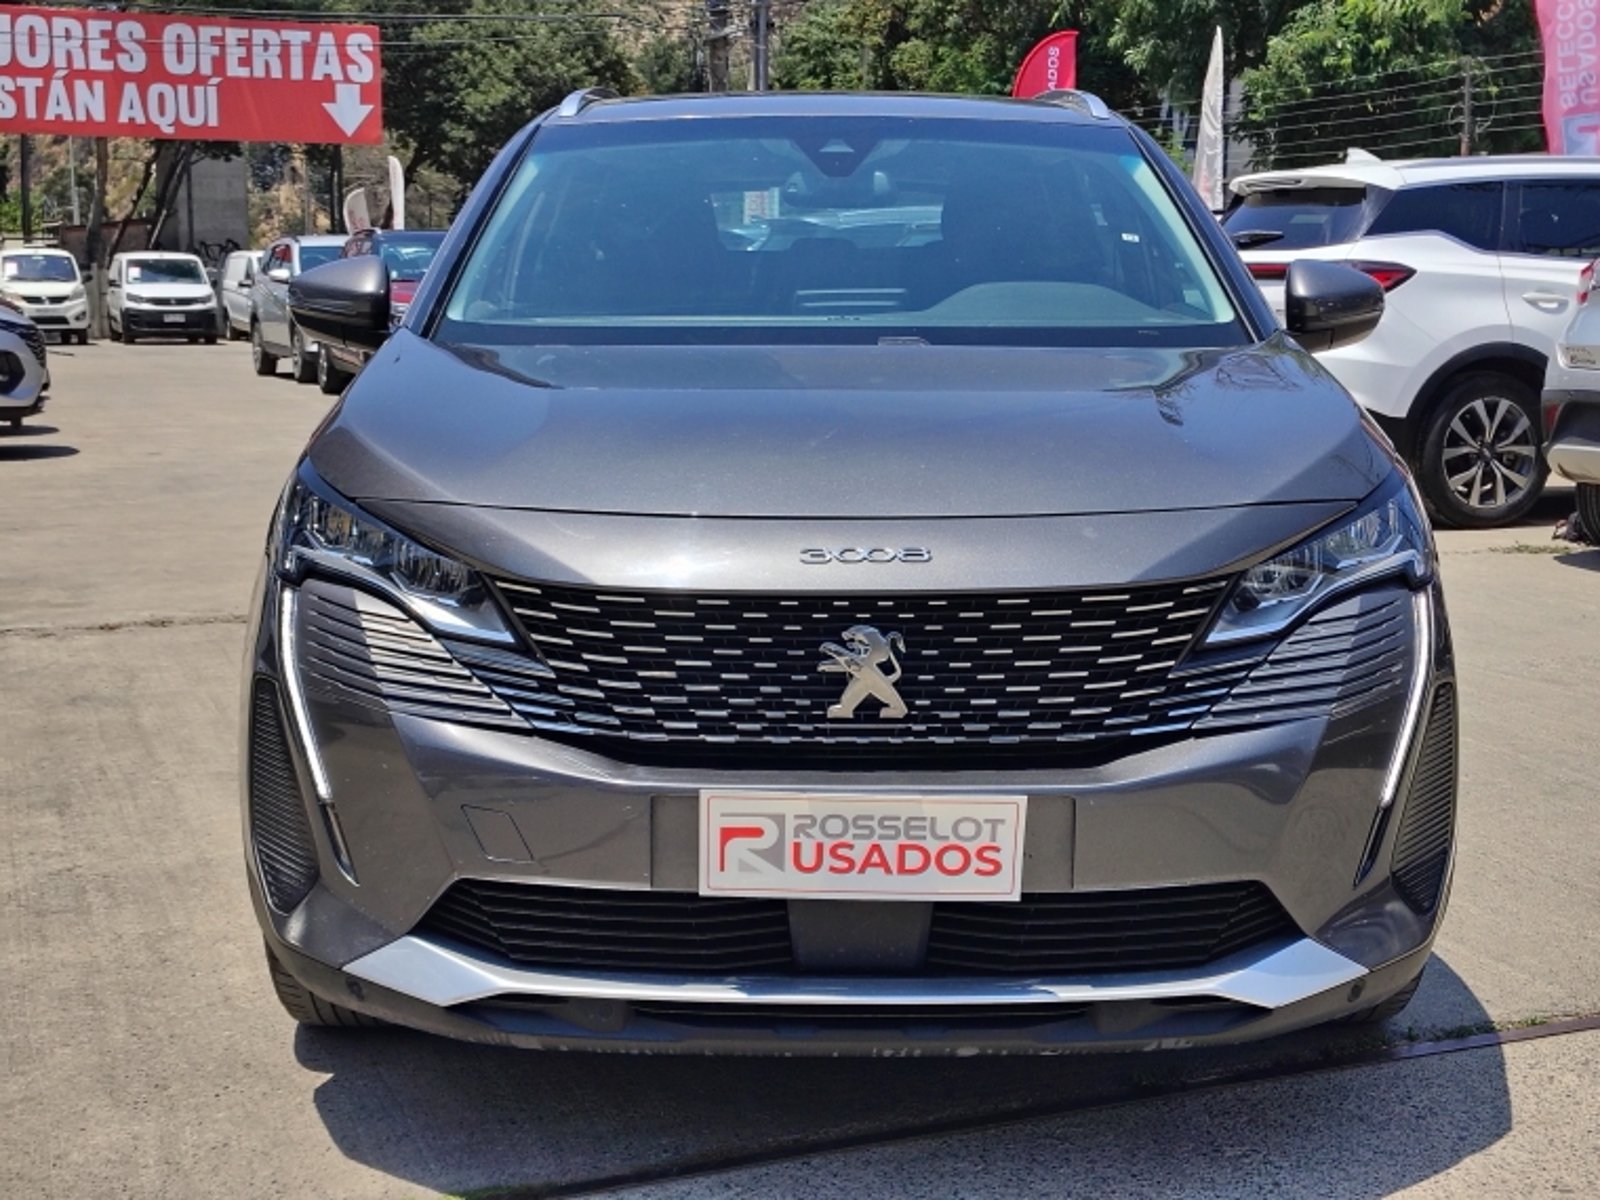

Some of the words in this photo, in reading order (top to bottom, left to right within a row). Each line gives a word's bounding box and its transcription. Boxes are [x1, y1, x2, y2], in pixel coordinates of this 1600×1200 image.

[162, 22, 375, 84] OFERTAS
[118, 77, 223, 134] AQUÍ
[799, 547, 934, 565] 3008
[792, 813, 1006, 843] ROSSELOT
[791, 841, 1004, 877] USADOS
